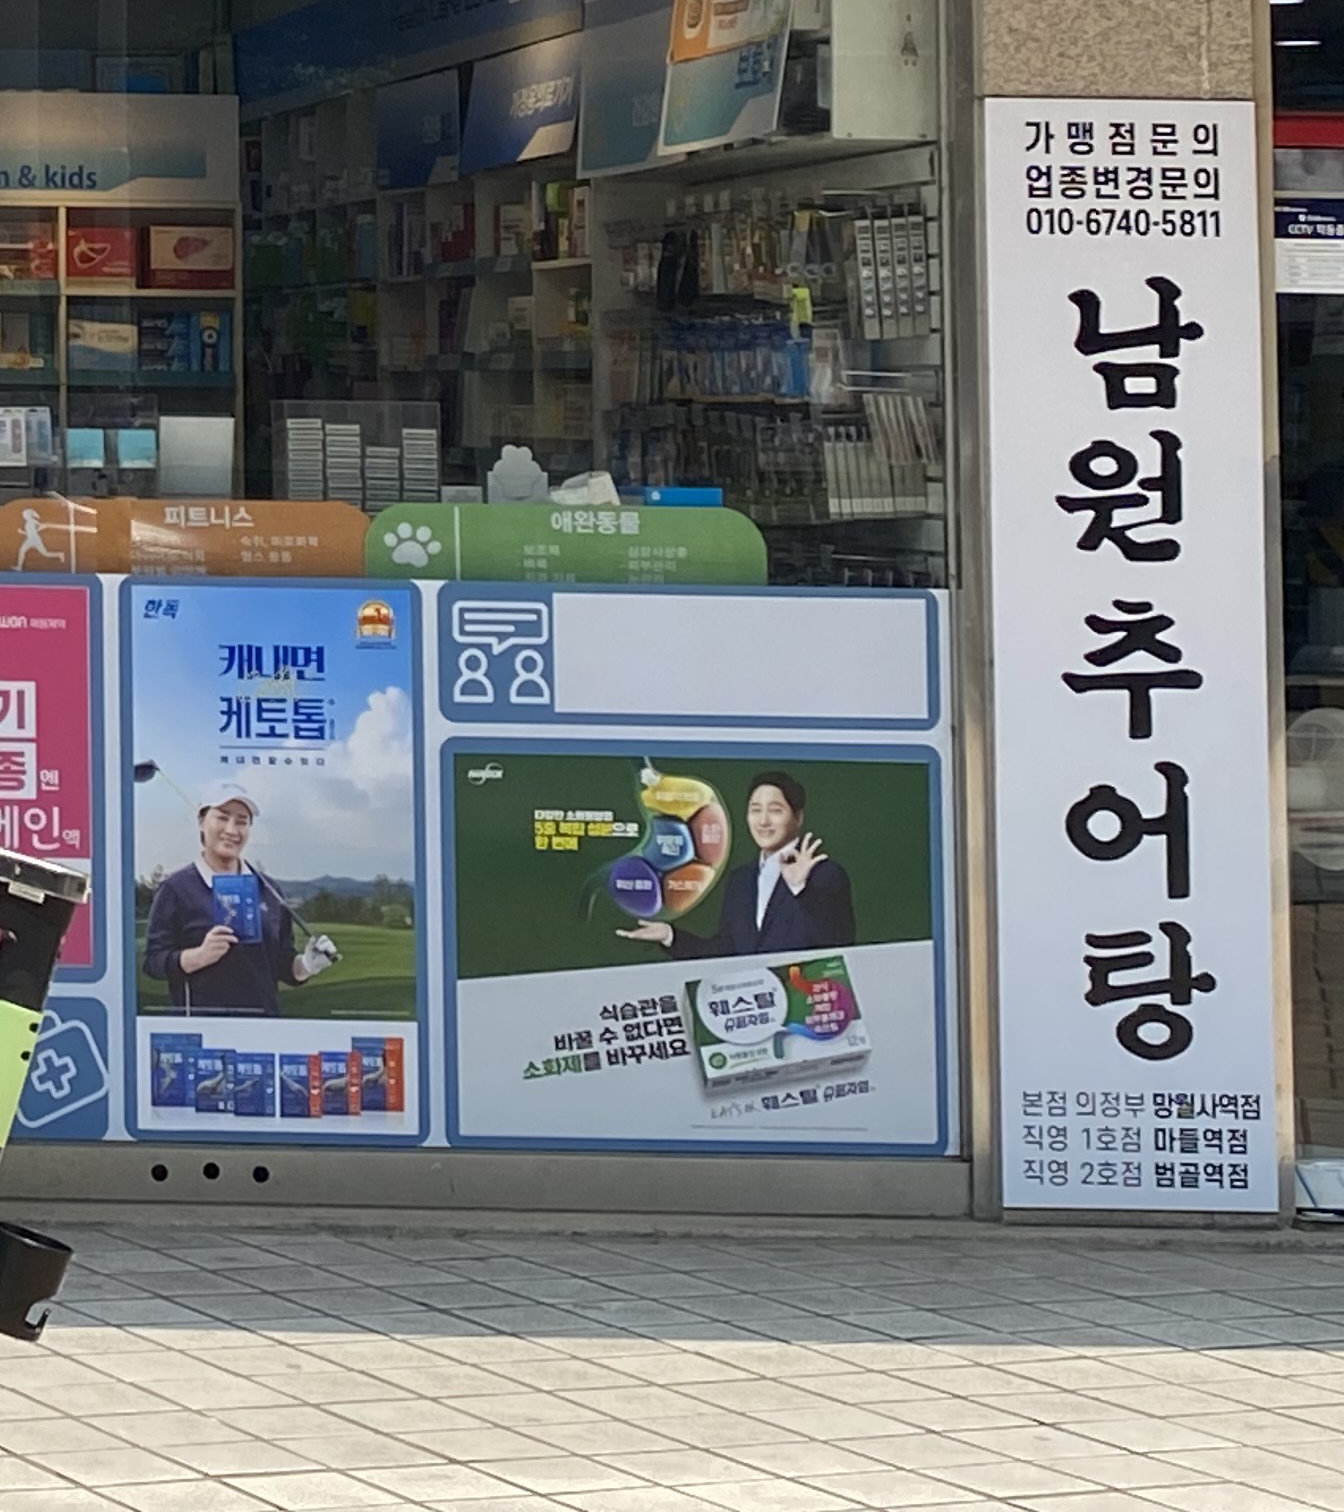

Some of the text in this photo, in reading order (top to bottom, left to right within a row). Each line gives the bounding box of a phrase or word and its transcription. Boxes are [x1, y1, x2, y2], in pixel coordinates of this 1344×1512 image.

[17, 164, 40, 187] &
[44, 163, 98, 188] kids
[1025, 164, 1222, 201] 업종변경문의
[1025, 207, 1222, 238] 010-6740-5811
[163, 505, 255, 529] 피트니스
[550, 510, 641, 534] 애완동물
[143, 598, 180, 620] 한독
[217, 643, 327, 682] 캐내면
[1055, 275, 1217, 1062] 남원추어탕
[218, 695, 327, 741] 케토톱
[599, 994, 679, 1022] 식습관을
[553, 1015, 686, 1052] 바꿀 수 없다면
[522, 1038, 692, 1080] 소화제를 바꾸세요
[1022, 1090, 1263, 1121] 본점 의정부 망월사역점
[1022, 1124, 1249, 1156] 직영 1호점 마들역점
[1022, 1158, 1250, 1190] 직영 2호점 범골역점
